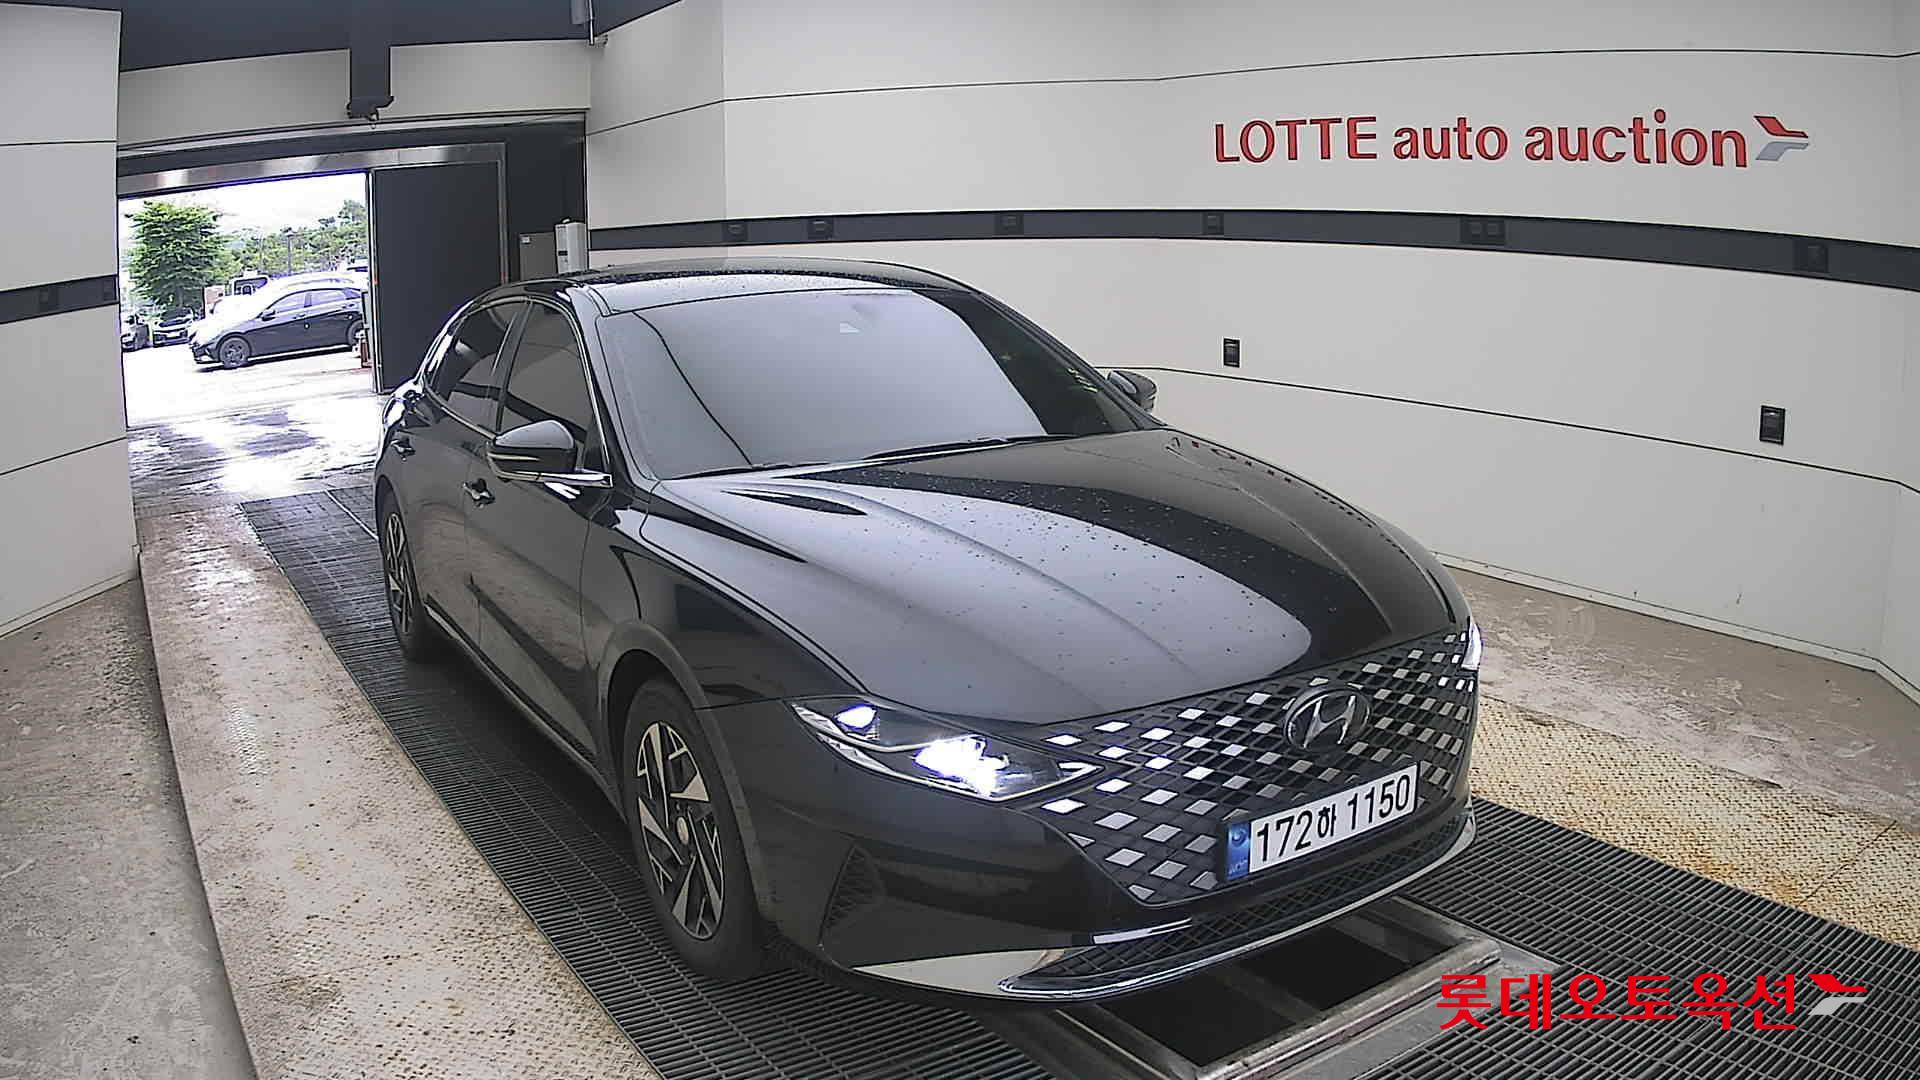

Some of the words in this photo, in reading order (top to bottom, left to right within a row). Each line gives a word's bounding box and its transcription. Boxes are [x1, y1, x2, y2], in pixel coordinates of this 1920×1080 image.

[1214, 116, 1377, 162] LOTTE
[1392, 117, 1509, 161] auto
[1523, 109, 1748, 168] auction
[1256, 803, 1337, 862] 172하
[1347, 774, 1411, 831] 1150
